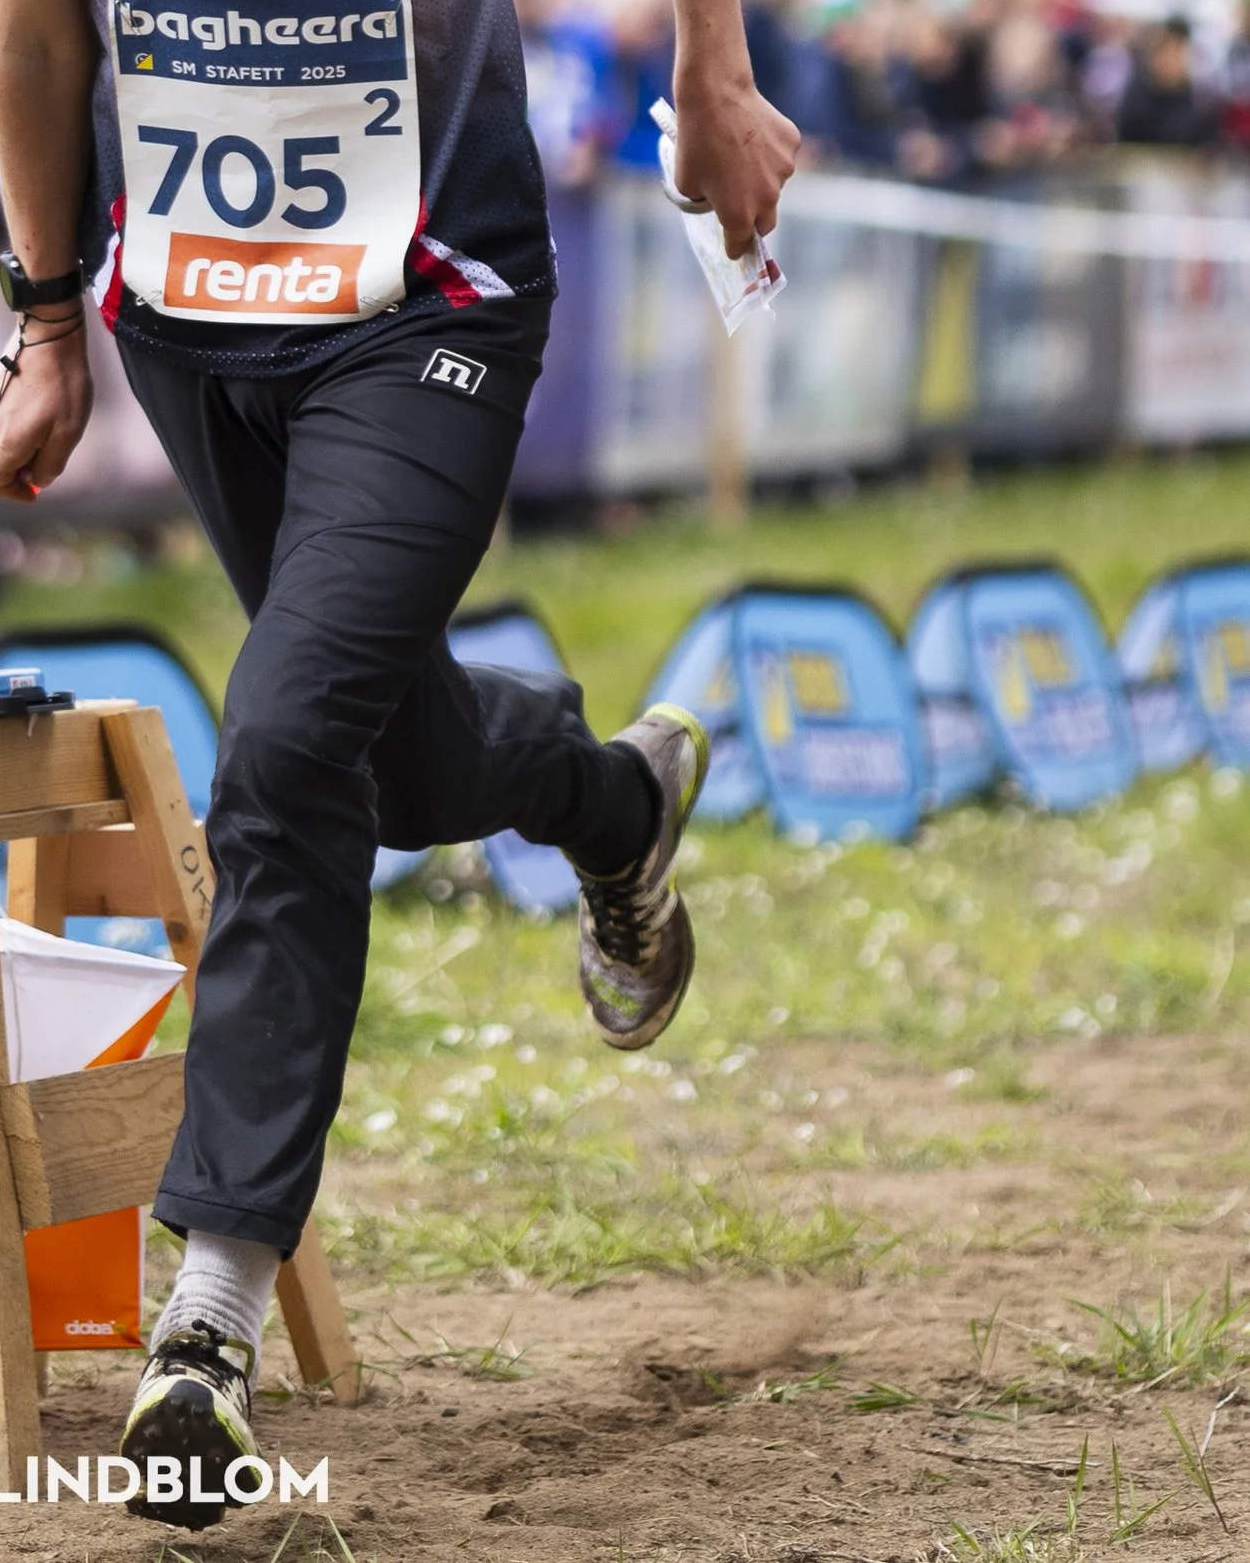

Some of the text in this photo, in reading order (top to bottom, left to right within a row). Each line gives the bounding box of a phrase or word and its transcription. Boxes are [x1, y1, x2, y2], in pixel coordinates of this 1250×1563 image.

[120, 1, 398, 51] bagheera
[171, 59, 347, 81] SM STAFETT 2025
[363, 87, 404, 137] 2
[137, 124, 348, 231] 705
[182, 255, 343, 304] renta
